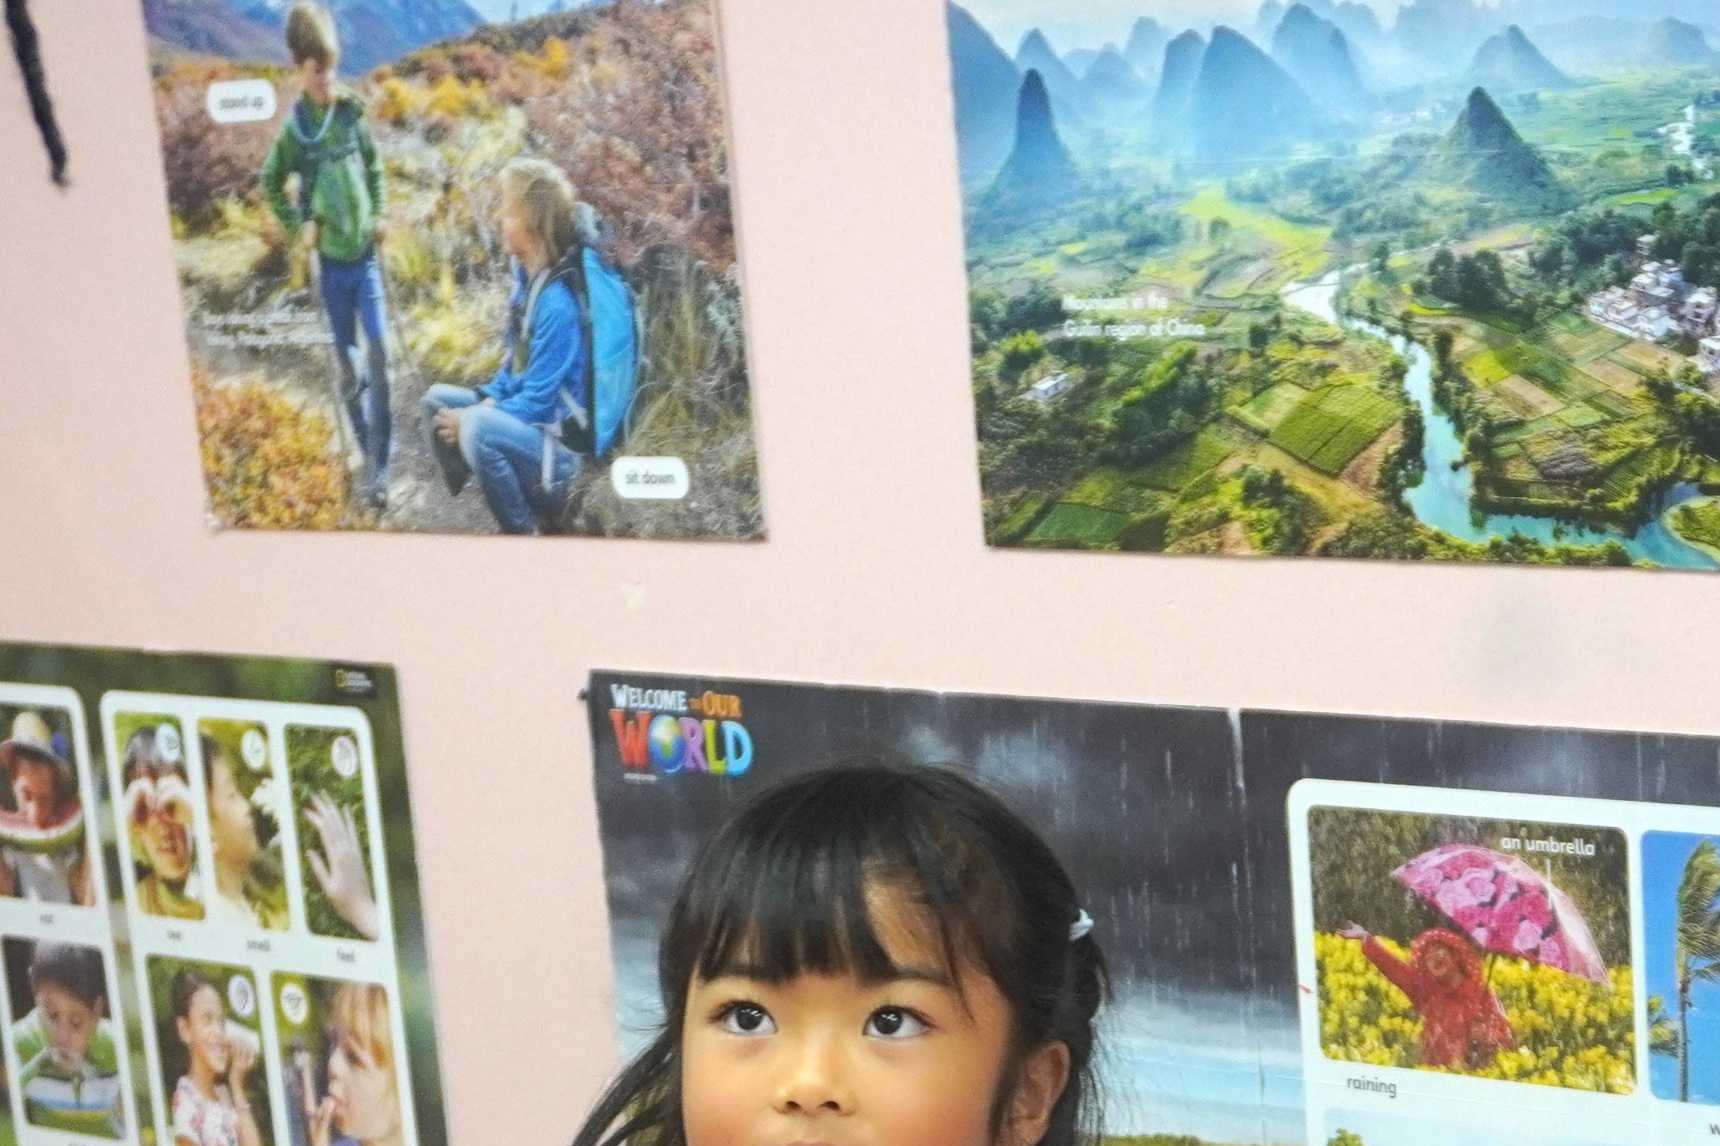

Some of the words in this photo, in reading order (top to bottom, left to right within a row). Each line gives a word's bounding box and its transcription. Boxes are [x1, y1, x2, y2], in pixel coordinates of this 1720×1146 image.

[610, 683, 690, 713] WELCOME
[702, 690, 743, 718] OUR
[609, 708, 753, 776] WORLD
[1501, 837, 1521, 850] an
[1525, 835, 1596, 856] umbrella
[1347, 1075, 1397, 1099] raining
